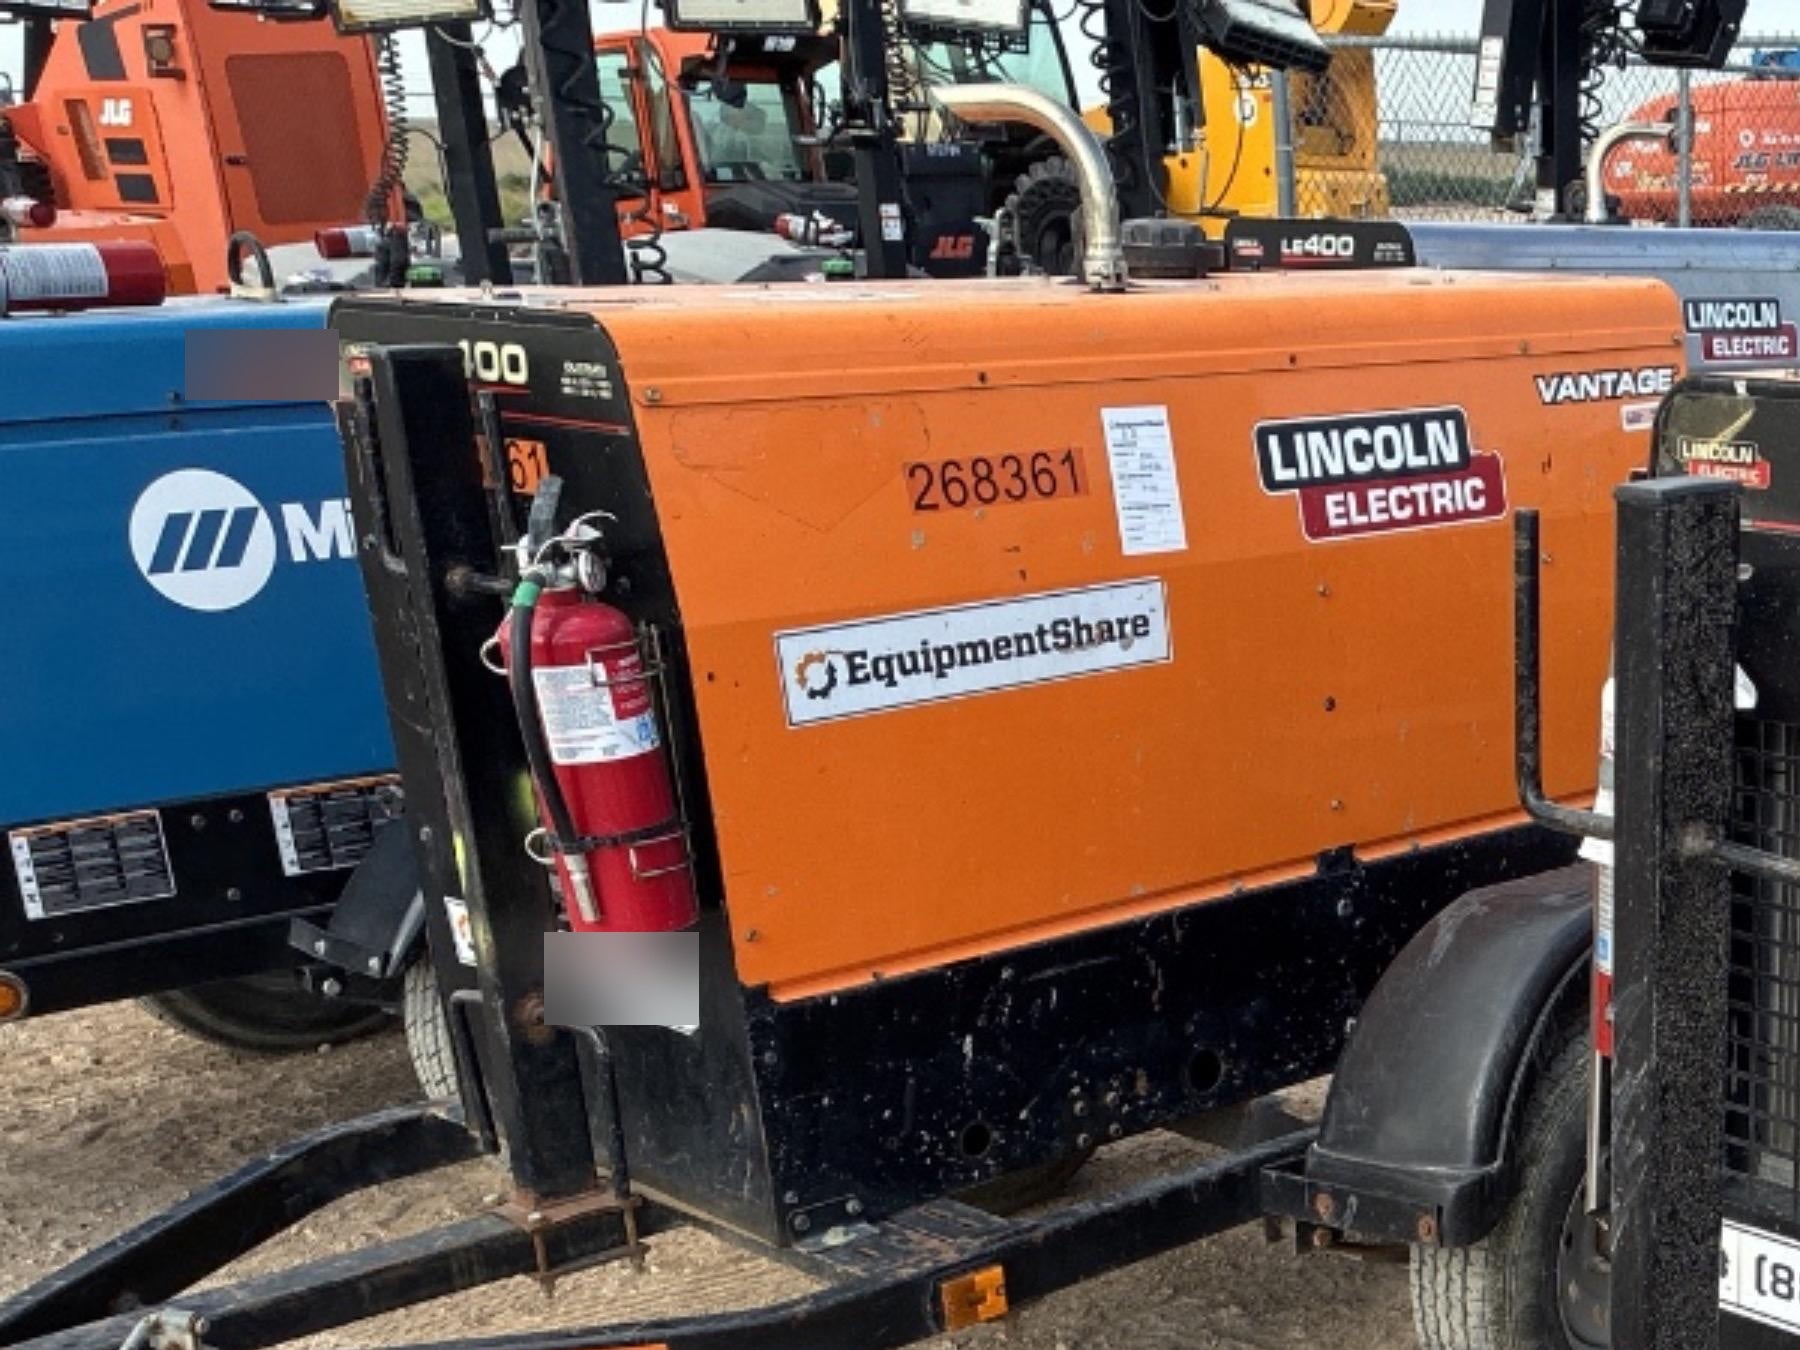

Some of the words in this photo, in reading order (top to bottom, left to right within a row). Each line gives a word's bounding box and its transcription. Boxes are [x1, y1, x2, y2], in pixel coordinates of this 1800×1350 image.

[99, 97, 132, 126] JLG
[1687, 302, 1778, 329] LINCOLN
[1711, 335, 1790, 356] ELECTRIC
[1535, 367, 1675, 404] VANTAGE
[1268, 419, 1460, 481] LINCOLN
[1682, 440, 1754, 463] LINCOLN
[908, 448, 1081, 511] 268361
[1325, 477, 1486, 528] ELECTRIC
[846, 611, 1151, 689] EquipmentShare
